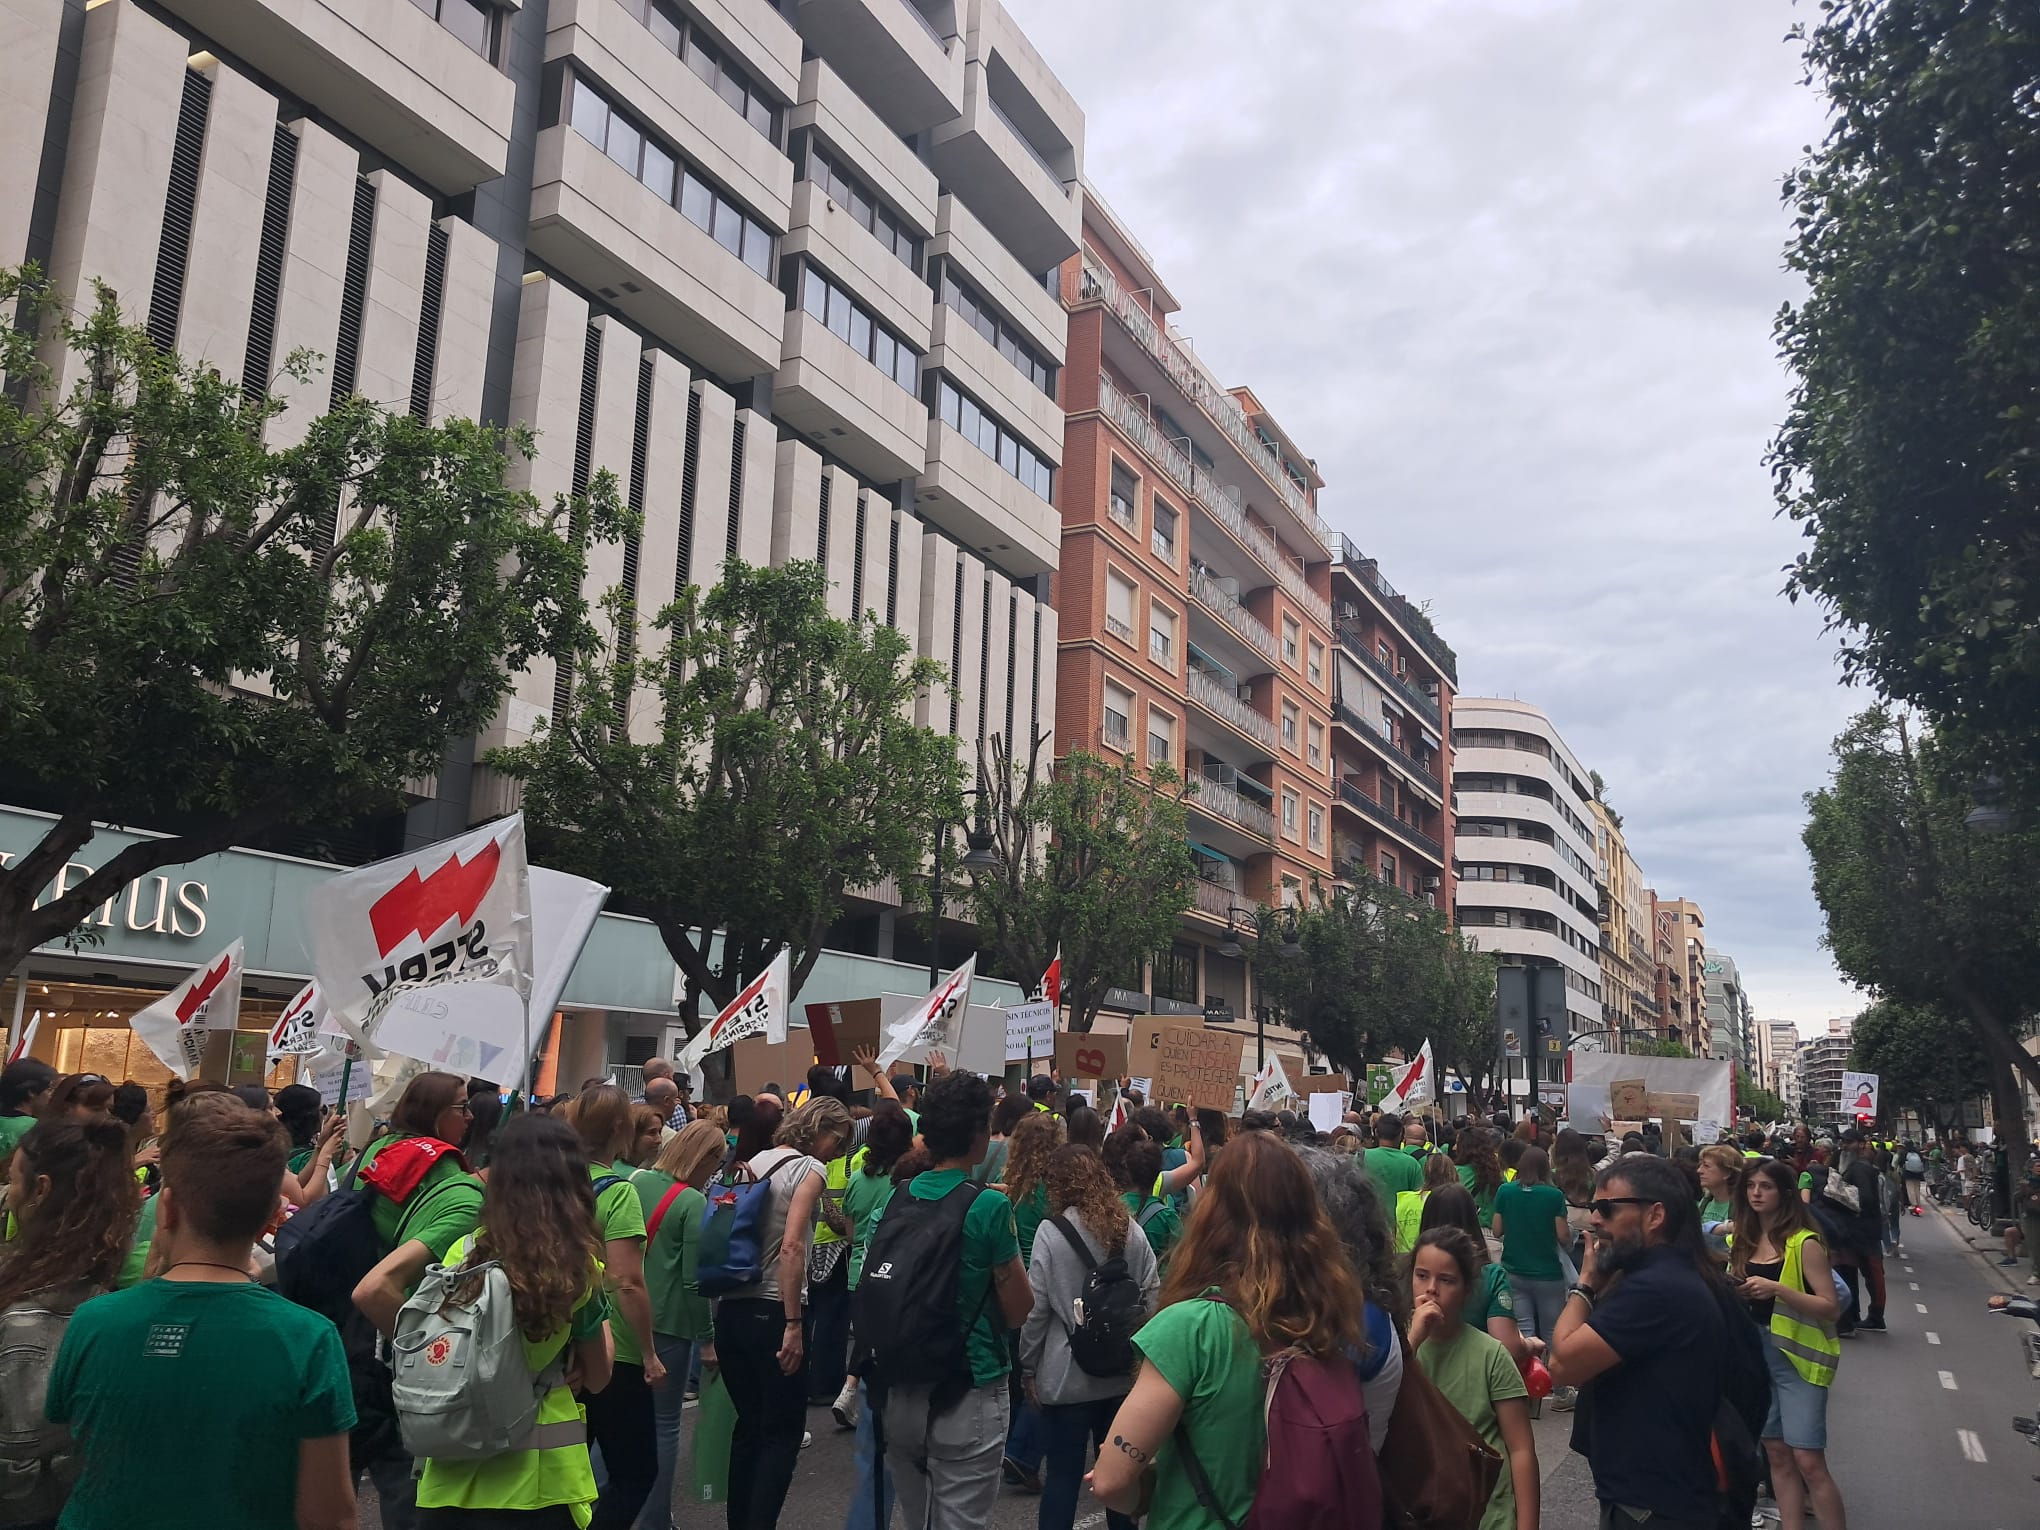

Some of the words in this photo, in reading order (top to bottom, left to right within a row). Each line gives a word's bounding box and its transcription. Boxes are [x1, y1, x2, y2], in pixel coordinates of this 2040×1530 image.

[1006, 1013, 1019, 1021] SIN
[1006, 1024, 1051, 1036] CUALIFICADOS
[1166, 1028, 1217, 1049] CUIDAR
[1223, 1036, 1232, 1051] A
[1162, 1046, 1190, 1060] QUIEN
[1159, 1074, 1166, 1084] A
[1160, 1061, 1171, 1072] ES
[1173, 1064, 1234, 1084] PROTEGER
[1156, 1084, 1185, 1099] QUIEN
